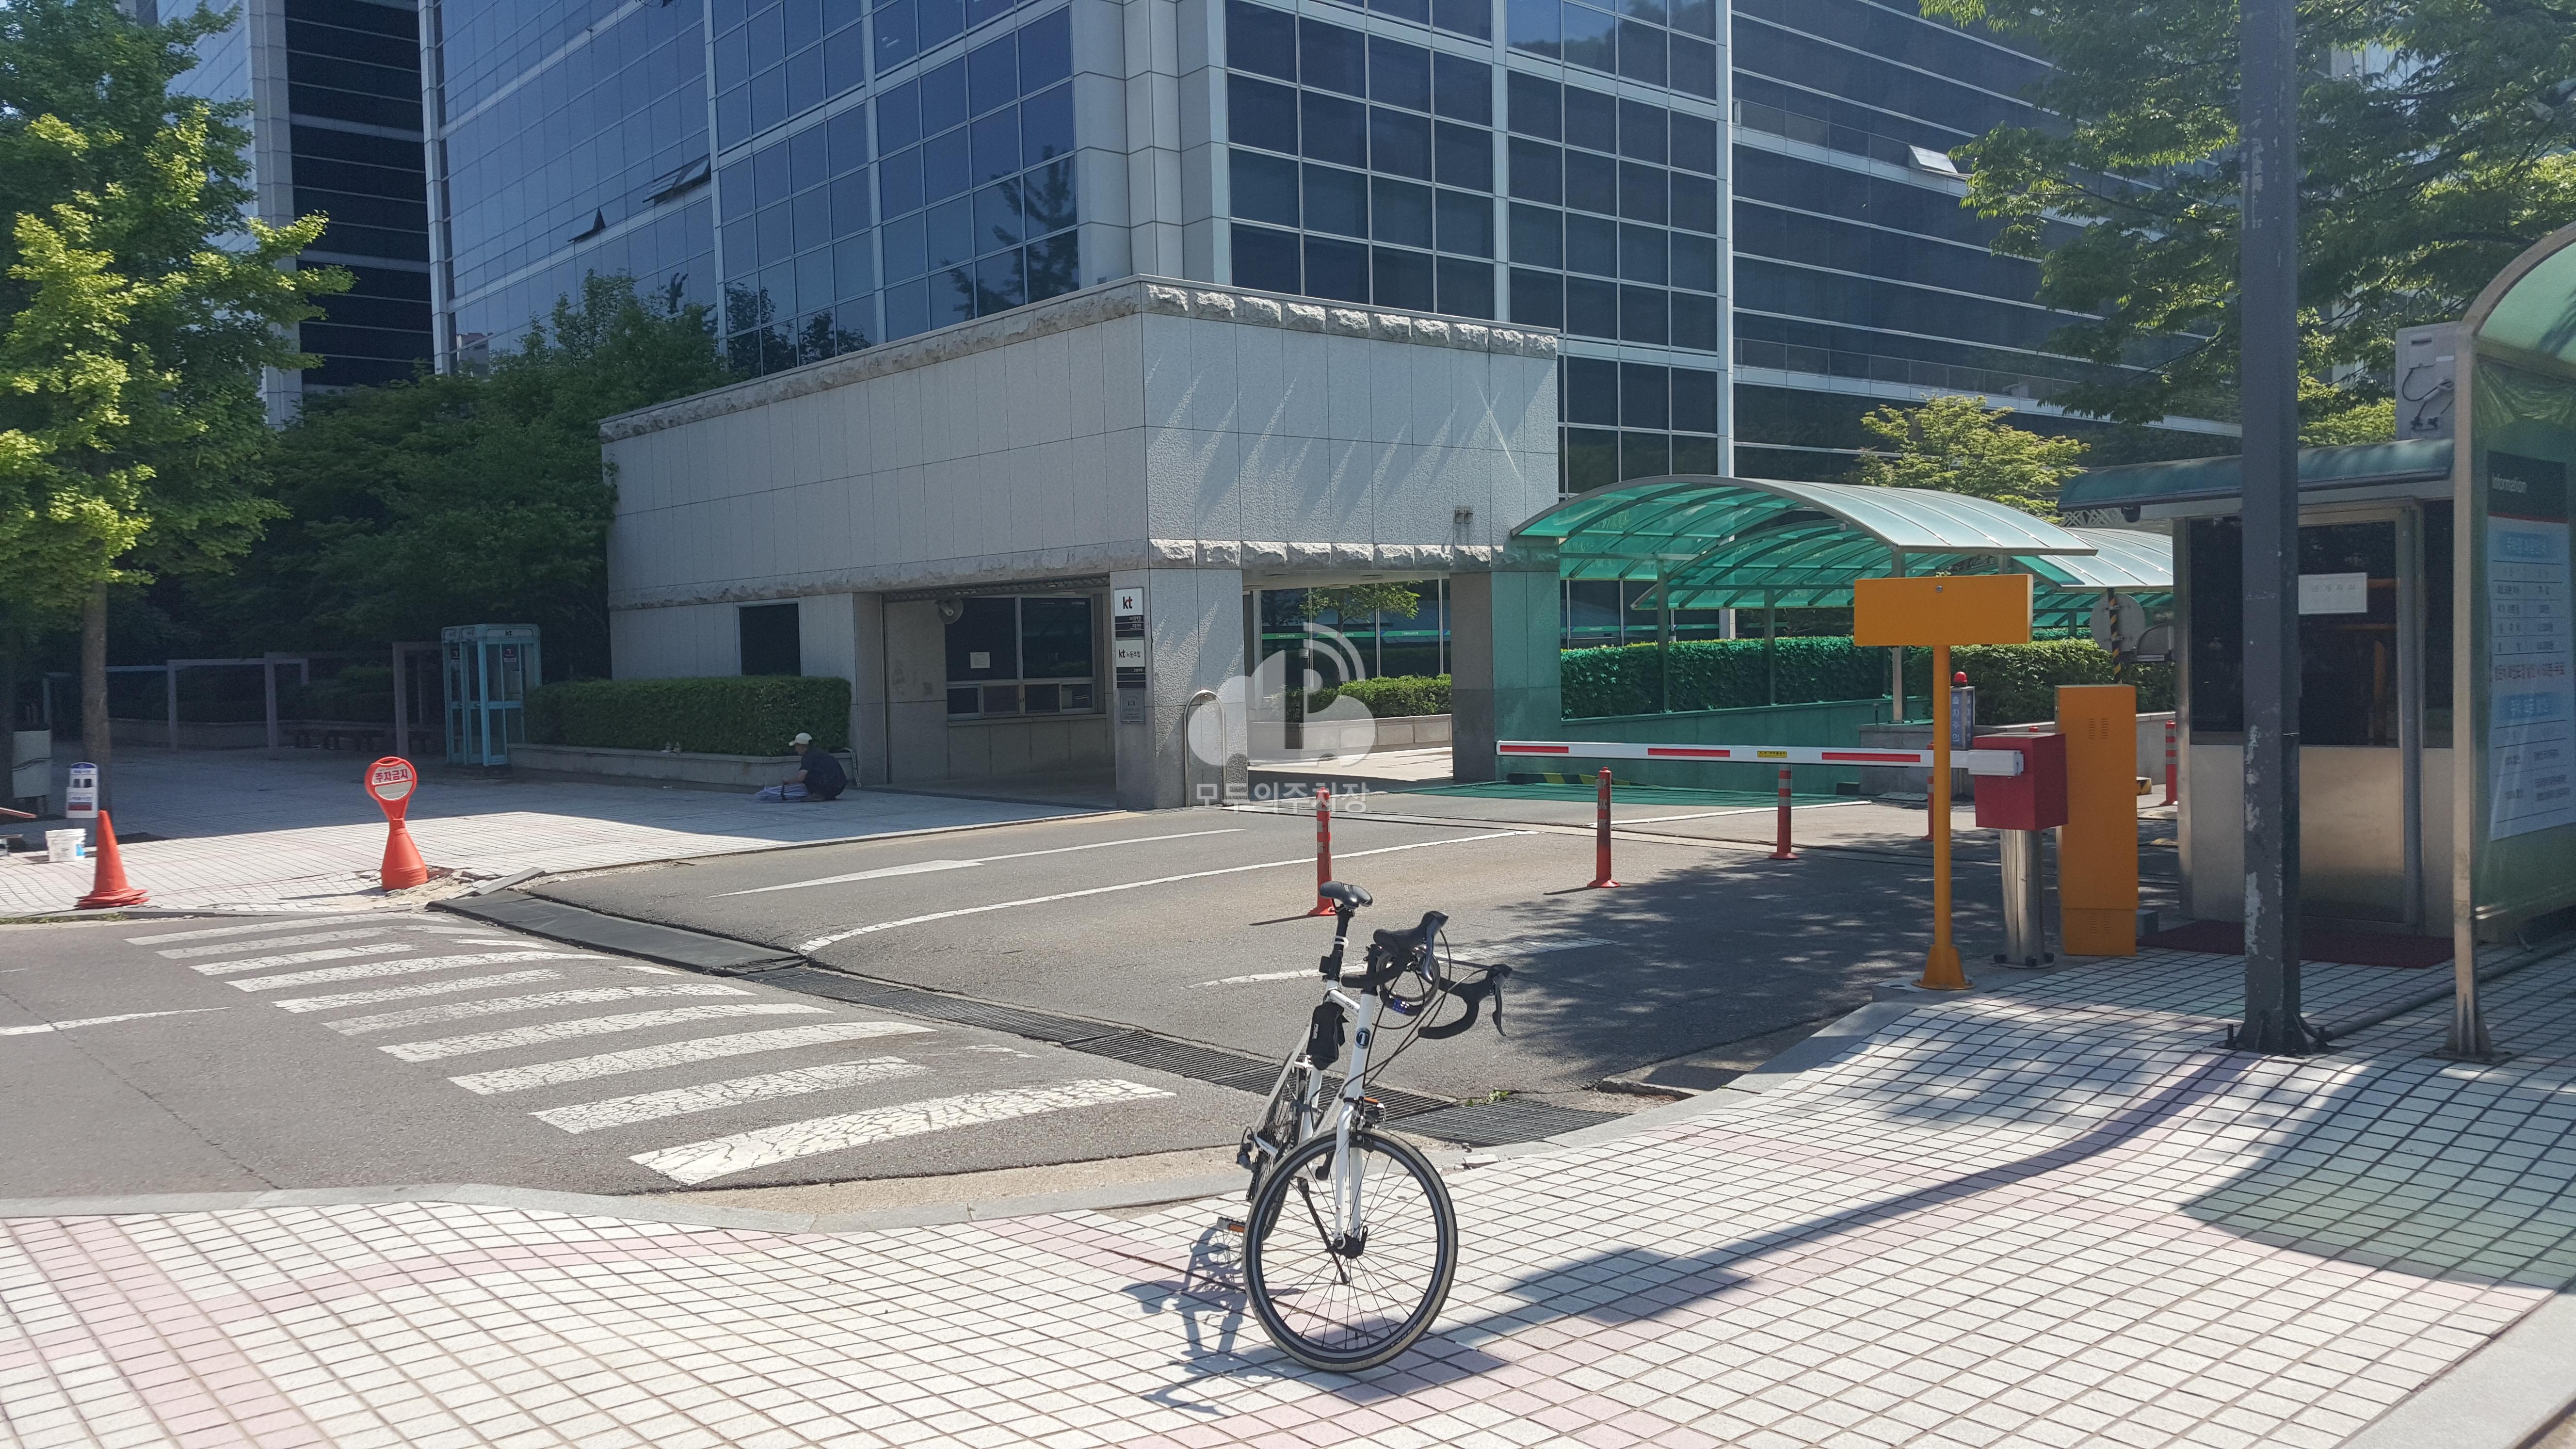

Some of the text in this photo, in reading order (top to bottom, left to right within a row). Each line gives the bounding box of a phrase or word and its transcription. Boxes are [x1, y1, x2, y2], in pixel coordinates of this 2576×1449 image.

[1123, 596, 1133, 609] kt
[1119, 649, 1125, 658] kt
[375, 769, 408, 783] 주차금지
